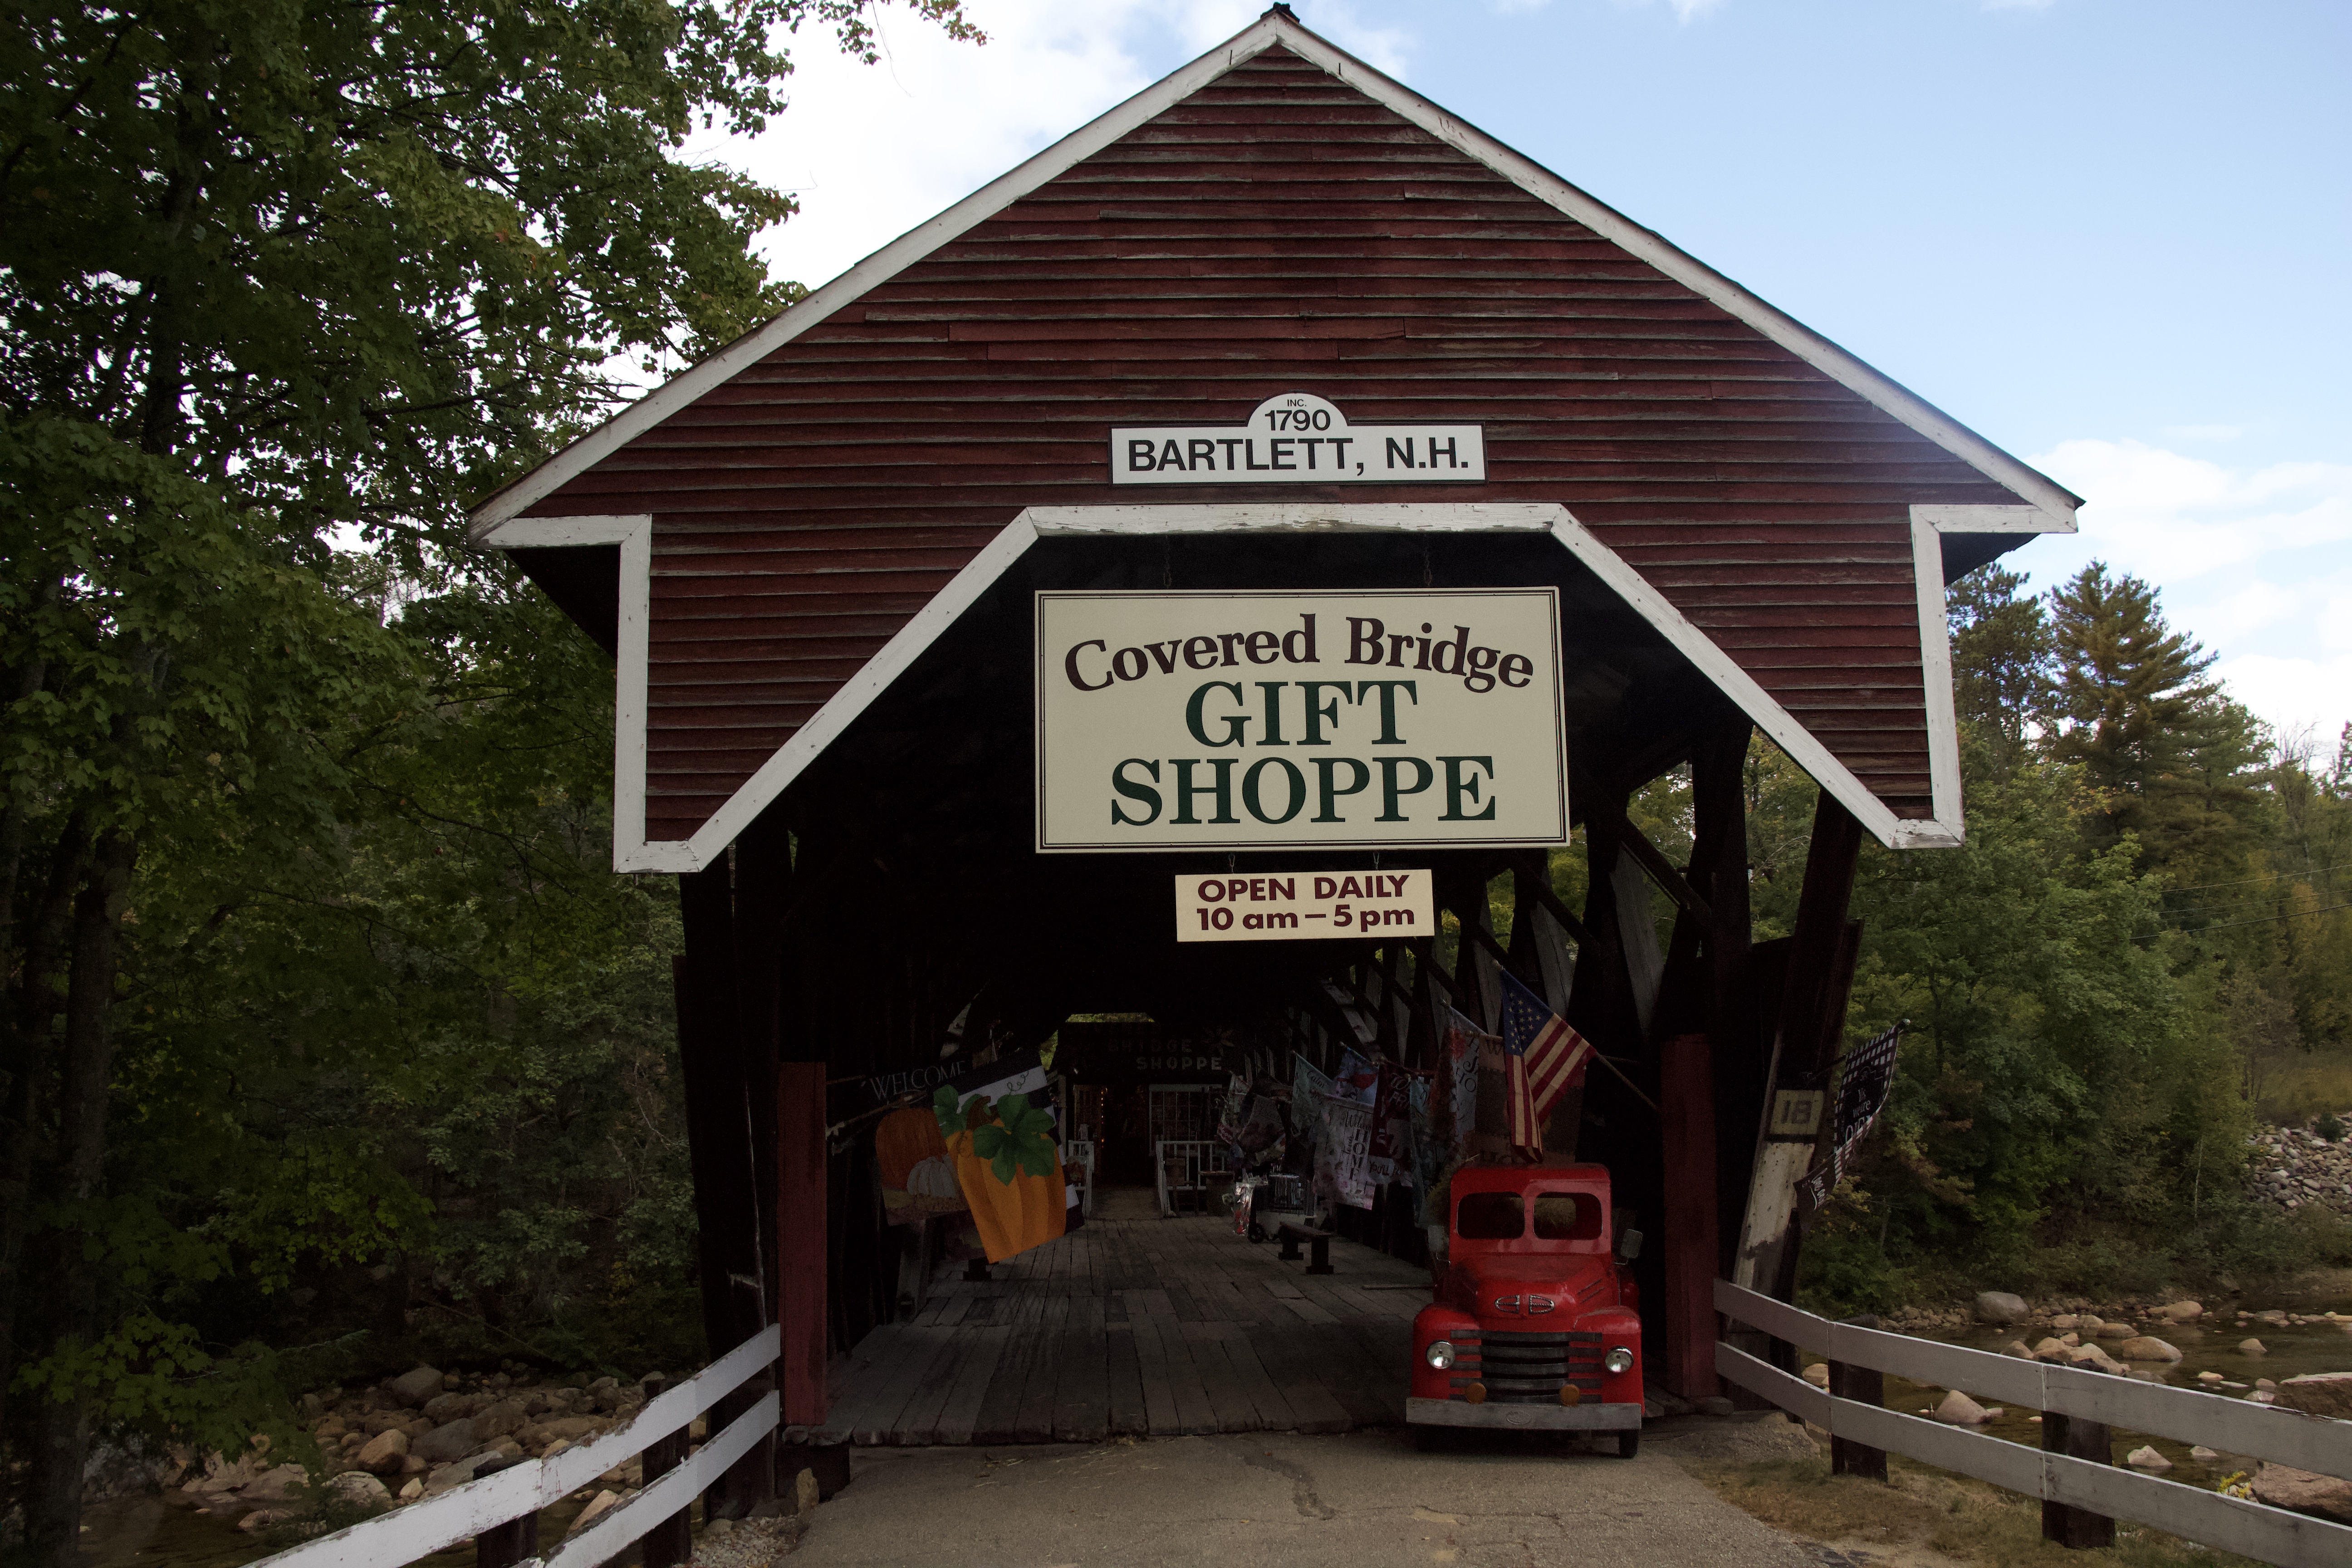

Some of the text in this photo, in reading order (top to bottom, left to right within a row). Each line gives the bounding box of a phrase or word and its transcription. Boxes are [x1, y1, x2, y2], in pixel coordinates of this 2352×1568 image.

[1287, 399, 1307, 407] INC.
[1265, 409, 1331, 431] 1790
[1128, 436, 1469, 476] BARTLETT, N.H.
[1064, 613, 1534, 694] Covered Bridge
[1185, 680, 1418, 748] GIFT
[1111, 755, 1496, 827] SHOPPE
[1198, 875, 1410, 902] OPEN DAILY
[1196, 907, 1234, 931] 10
[1242, 911, 1298, 930] am
[1333, 904, 1353, 927] 5
[1360, 908, 1415, 932] pm
[1107, 1039, 1192, 1053] BRIDGE
[1136, 1056, 1223, 1071] SHOPPE
[869, 1060, 966, 1100] WELCOME
[1781, 1100, 1813, 1124] 18
